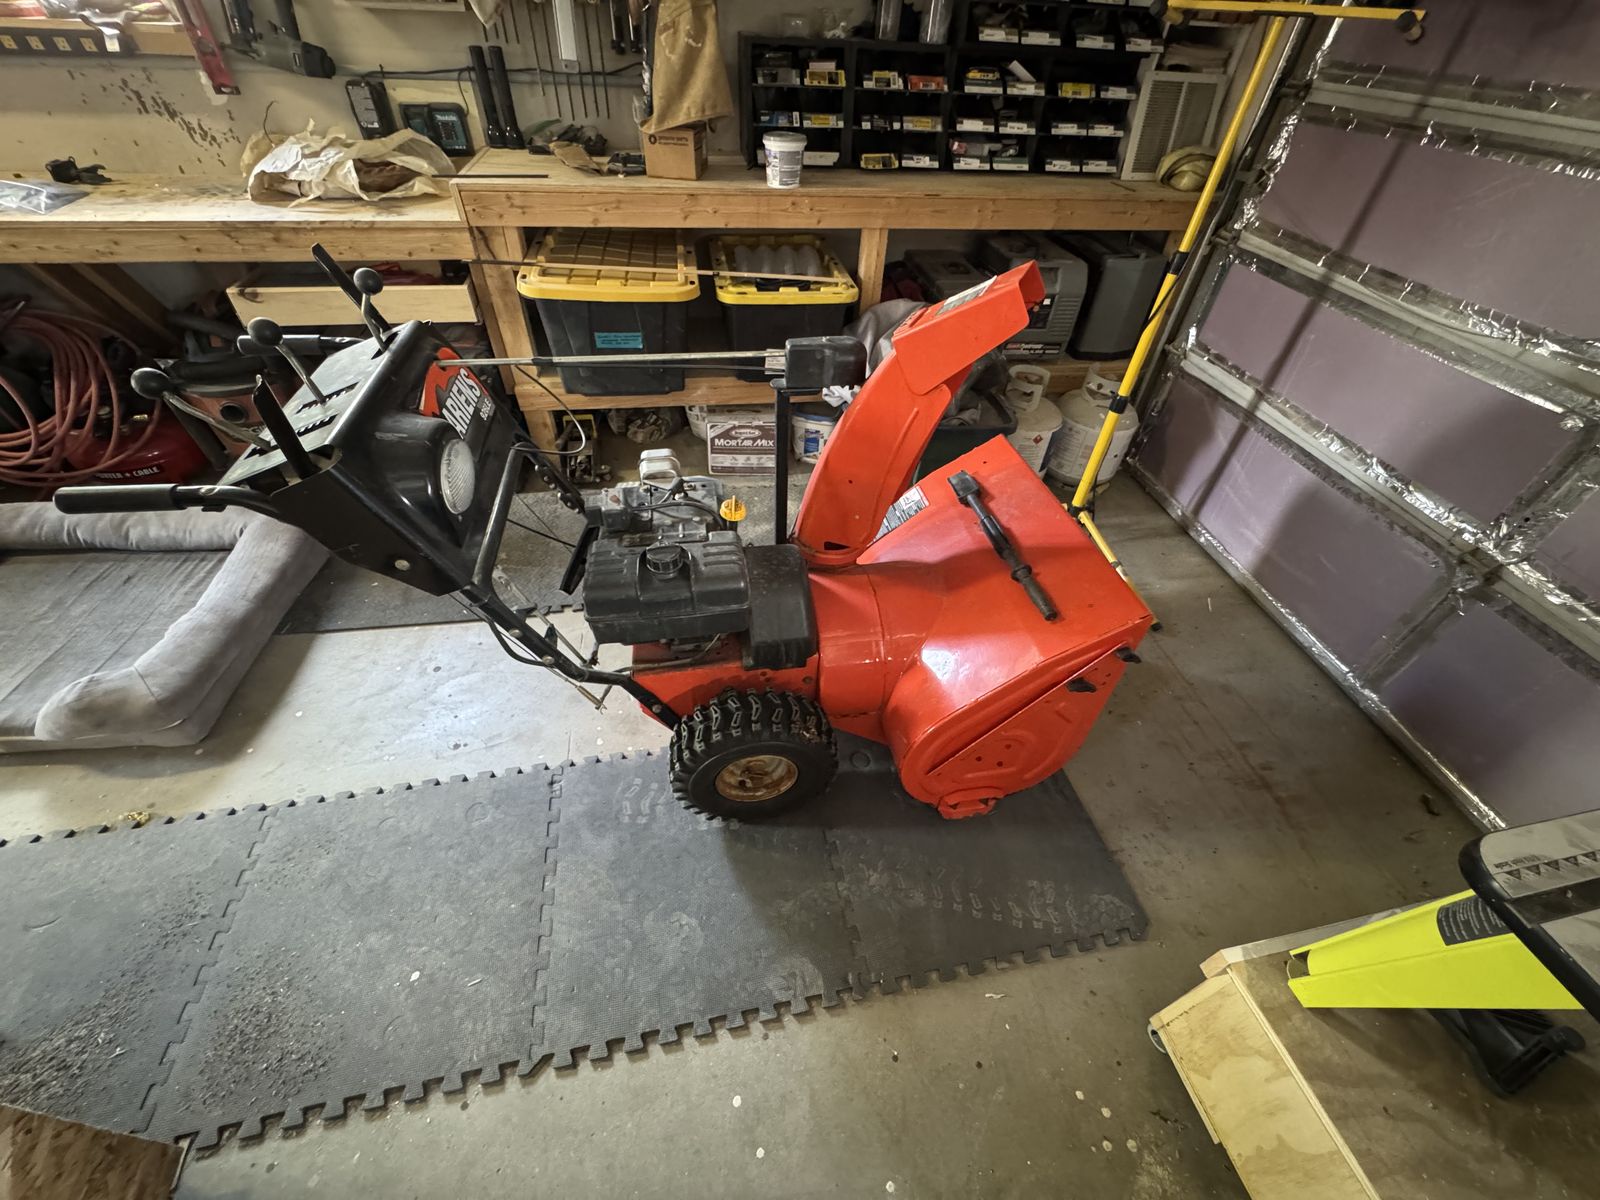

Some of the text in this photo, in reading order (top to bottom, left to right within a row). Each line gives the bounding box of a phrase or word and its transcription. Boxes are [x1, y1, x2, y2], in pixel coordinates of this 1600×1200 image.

[441, 367, 481, 439] ARIENS
[714, 437, 774, 447] MORTAR MIX
[132, 466, 160, 477] CABLE
